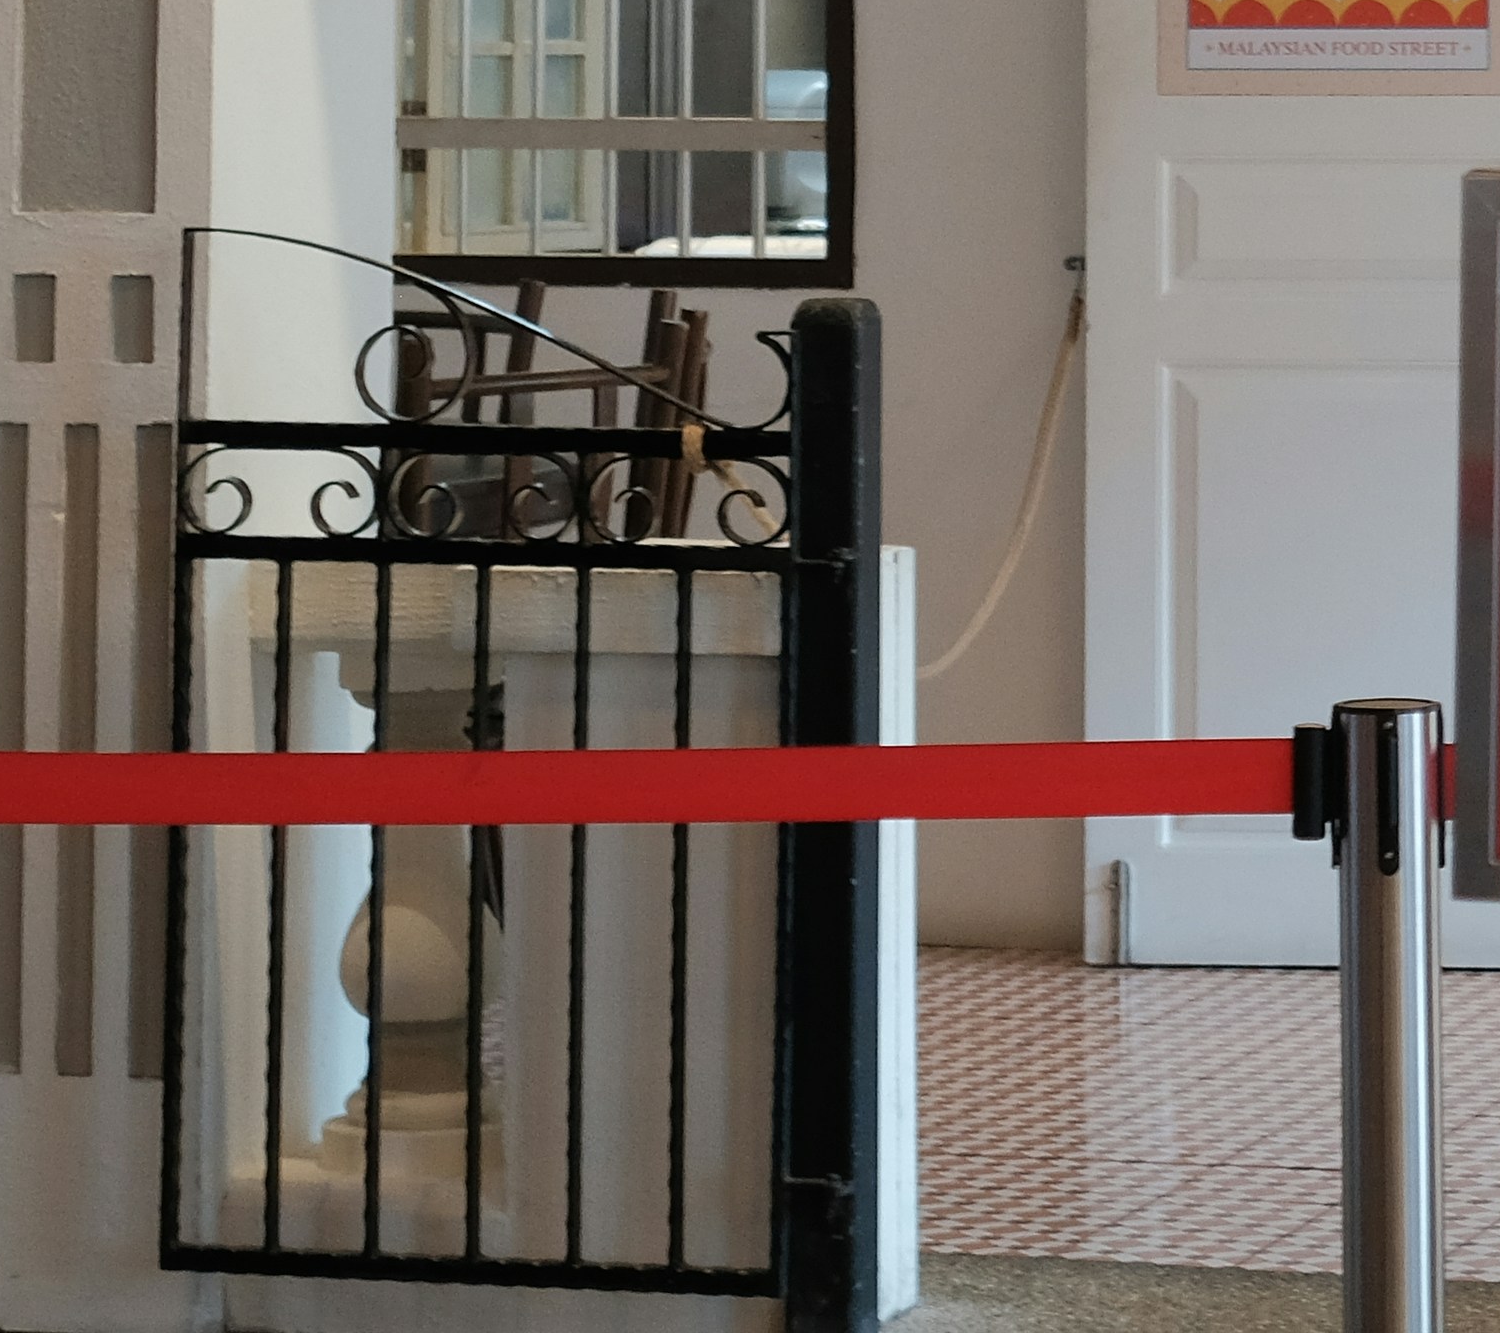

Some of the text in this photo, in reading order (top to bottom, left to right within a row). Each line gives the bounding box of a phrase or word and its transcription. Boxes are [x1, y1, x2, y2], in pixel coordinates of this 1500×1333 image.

[1217, 40, 1460, 57] MALAYSIAN FOOD STREET
